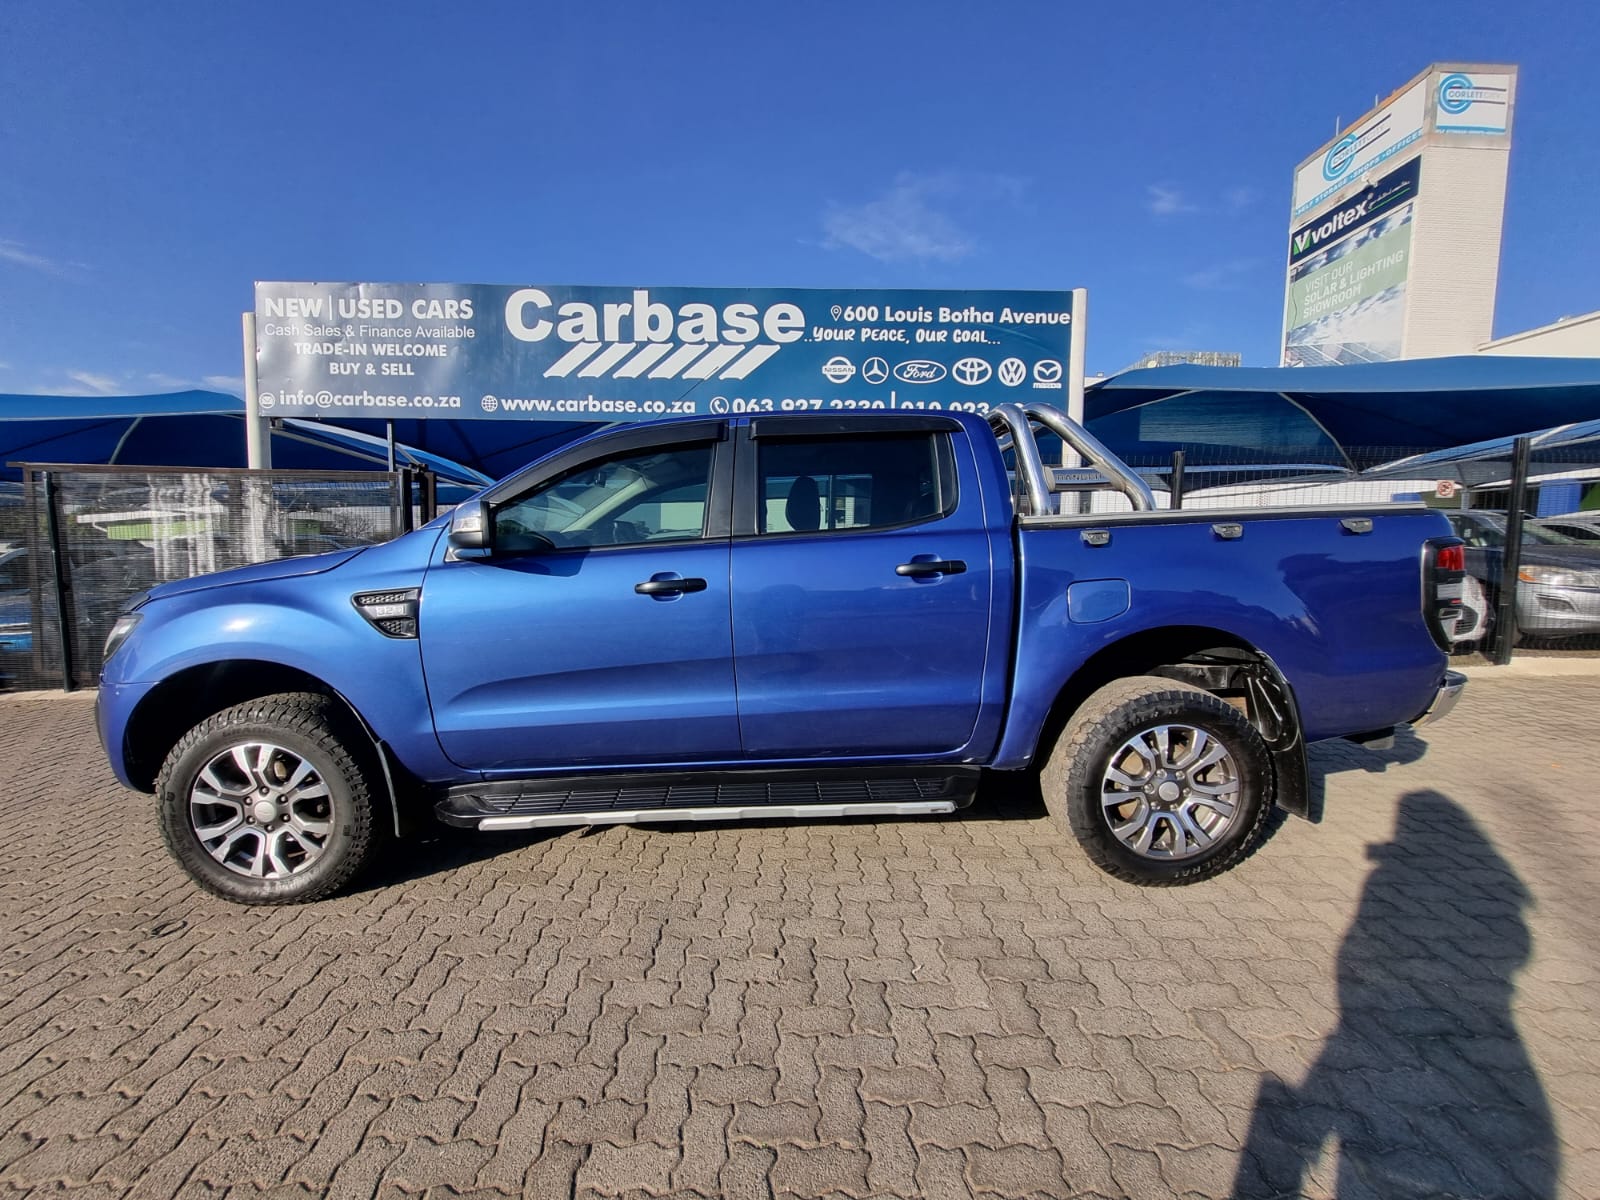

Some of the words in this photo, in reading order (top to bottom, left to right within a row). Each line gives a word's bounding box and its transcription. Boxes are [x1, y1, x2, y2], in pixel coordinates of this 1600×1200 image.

[1448, 90, 1483, 99] CORLETT
[1311, 200, 1368, 244] voltex
[1304, 282, 1338, 306] SOLAR
[1350, 250, 1404, 285] LIGHTING
[1305, 271, 1330, 293] VISIT
[1331, 261, 1354, 281] OUR
[264, 297, 323, 318] NEW
[337, 299, 403, 319] USED
[411, 299, 474, 319] CARS
[1303, 284, 1361, 319] SHOWROOM
[505, 288, 806, 343] Carbase
[843, 305, 879, 322] 600
[885, 306, 933, 323] Louis
[939, 306, 994, 323] Botha
[999, 307, 1071, 324] Avenue
[264, 323, 300, 337] Cash
[303, 324, 340, 337] Sales
[344, 325, 355, 337] &
[359, 325, 412, 338] Finance
[415, 325, 475, 339] Available
[915, 329, 948, 343] OUR
[294, 342, 367, 356] TRADE-IN
[371, 343, 447, 357] WELCOME
[329, 363, 360, 375] BUY
[364, 363, 376, 375] &
[381, 363, 415, 376] SELL
[824, 366, 855, 374] NISSAN
[903, 363, 936, 379] Ford
[279, 390, 461, 409] info@carbase.co.za
[500, 395, 696, 413] www.carbase.co.za
[732, 398, 773, 413] 063
